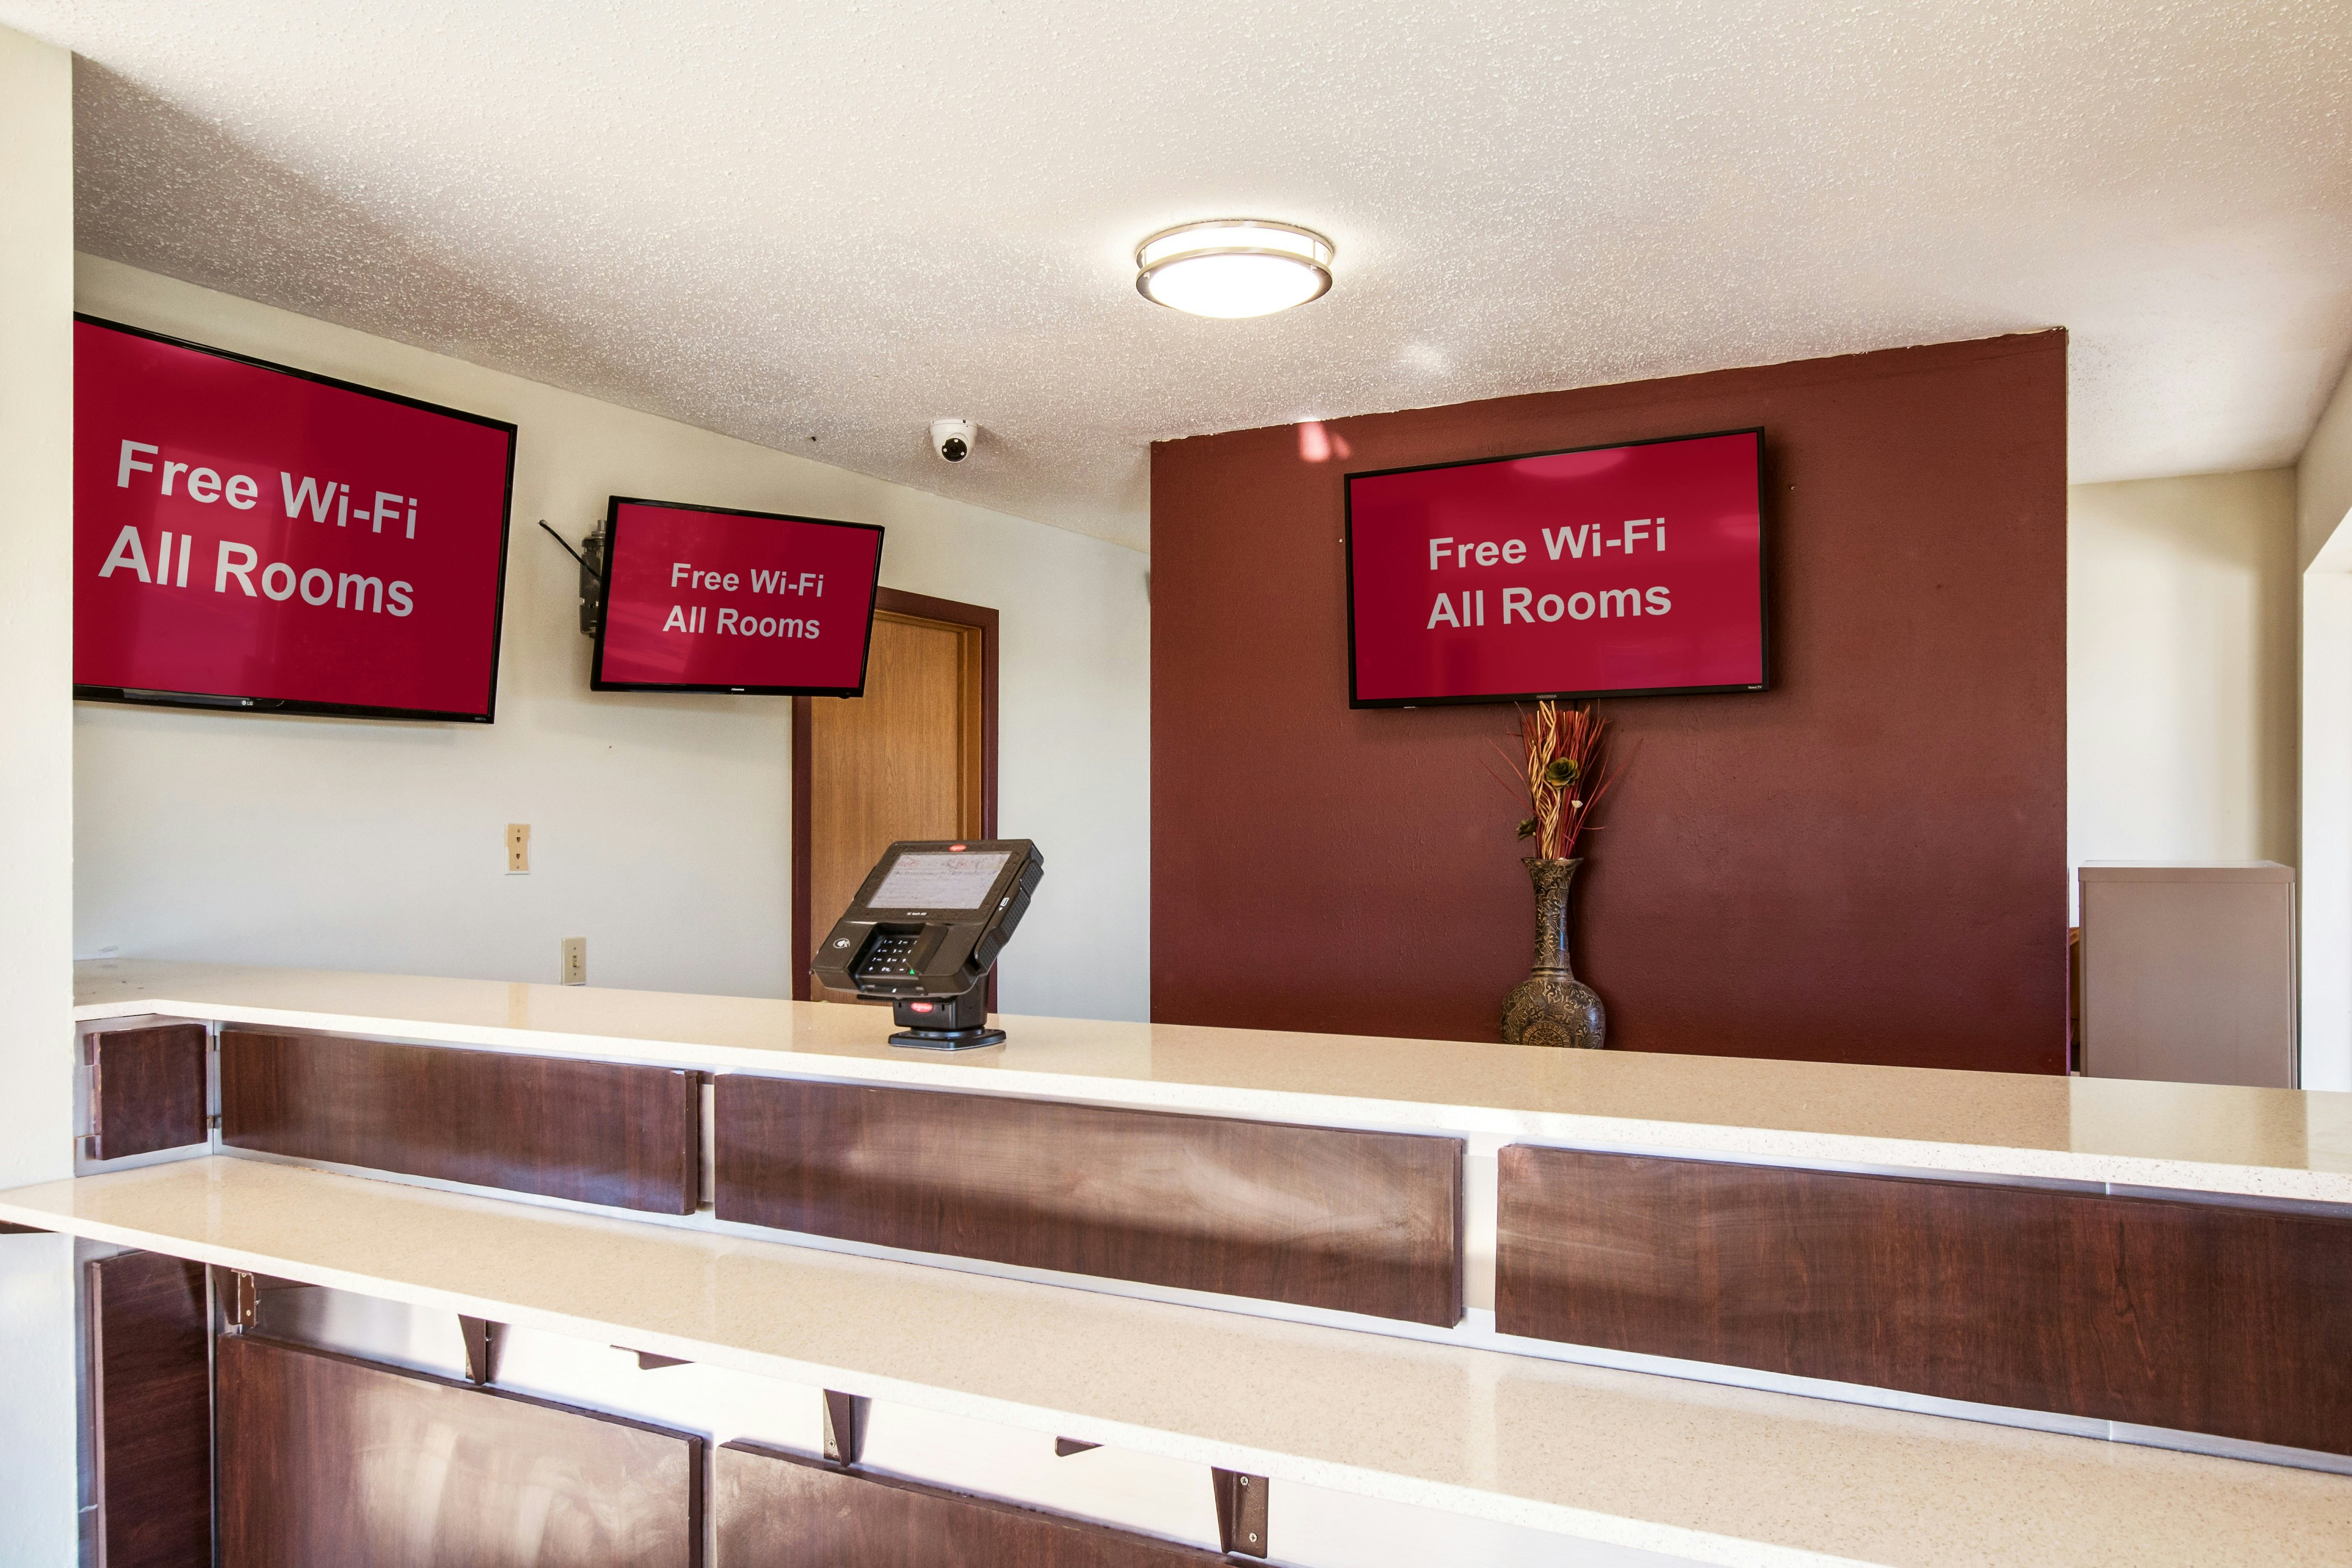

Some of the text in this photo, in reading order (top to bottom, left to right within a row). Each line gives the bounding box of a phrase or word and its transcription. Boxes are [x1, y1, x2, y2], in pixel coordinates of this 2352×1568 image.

[117, 439, 418, 539] Free Wi-Fi
[1429, 517, 1666, 570] Free Wi-Fi
[98, 525, 413, 617] All Rooms
[671, 562, 824, 597] Free Wi-Fi
[662, 605, 820, 639] All Rooms
[1426, 586, 1671, 629] All Rooms
